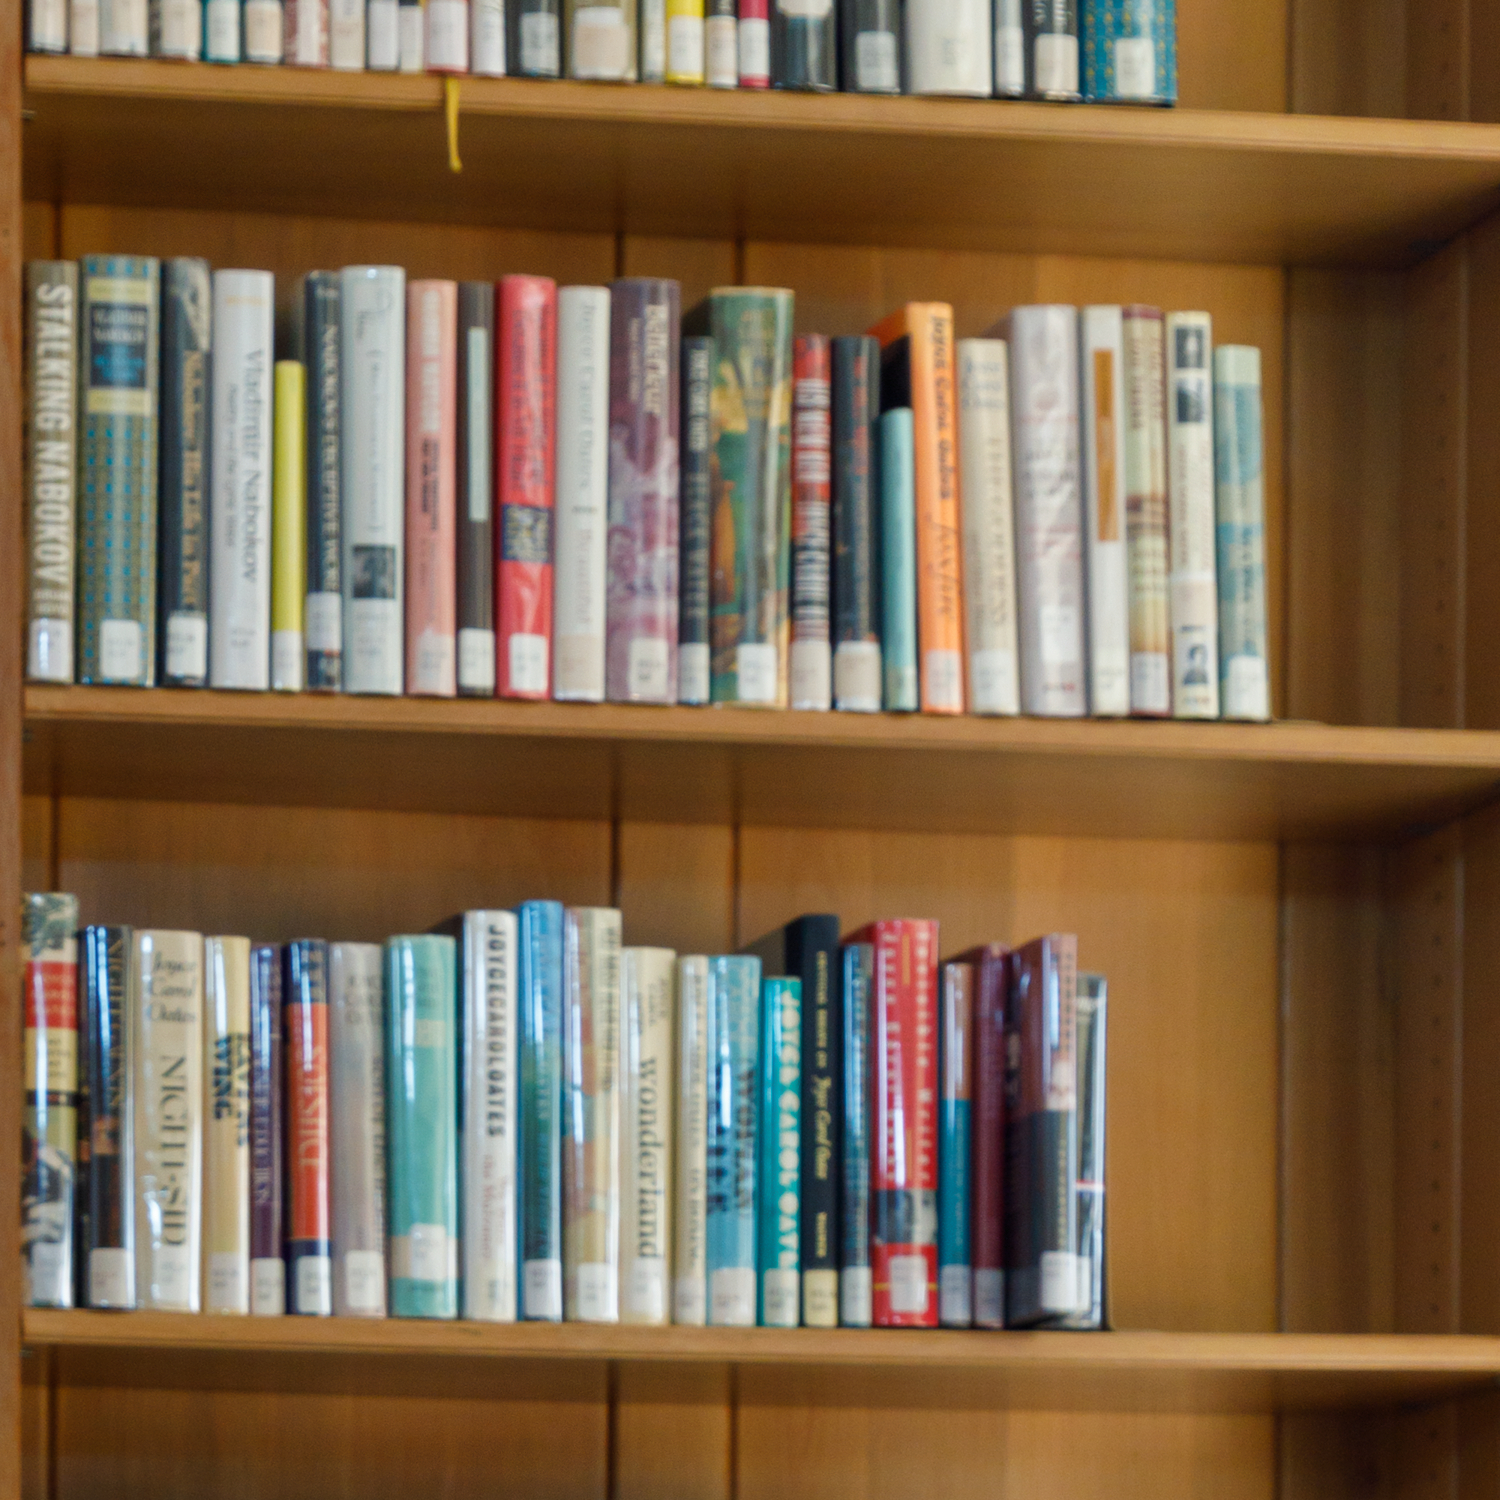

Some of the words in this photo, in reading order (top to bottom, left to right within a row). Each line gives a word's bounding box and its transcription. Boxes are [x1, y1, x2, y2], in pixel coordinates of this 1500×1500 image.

[35, 284, 71, 430] STALKING
[241, 350, 265, 460] Vladimir
[34, 441, 71, 585] NABOKOV
[240, 470, 264, 583] Nabokov
[214, 1035, 232, 1120] WING
[157, 1054, 189, 1248] NIGHT-SID
[637, 1057, 667, 1259] wonderland
[779, 1089, 800, 1186] CAROL
[779, 1192, 800, 1271] OATE
